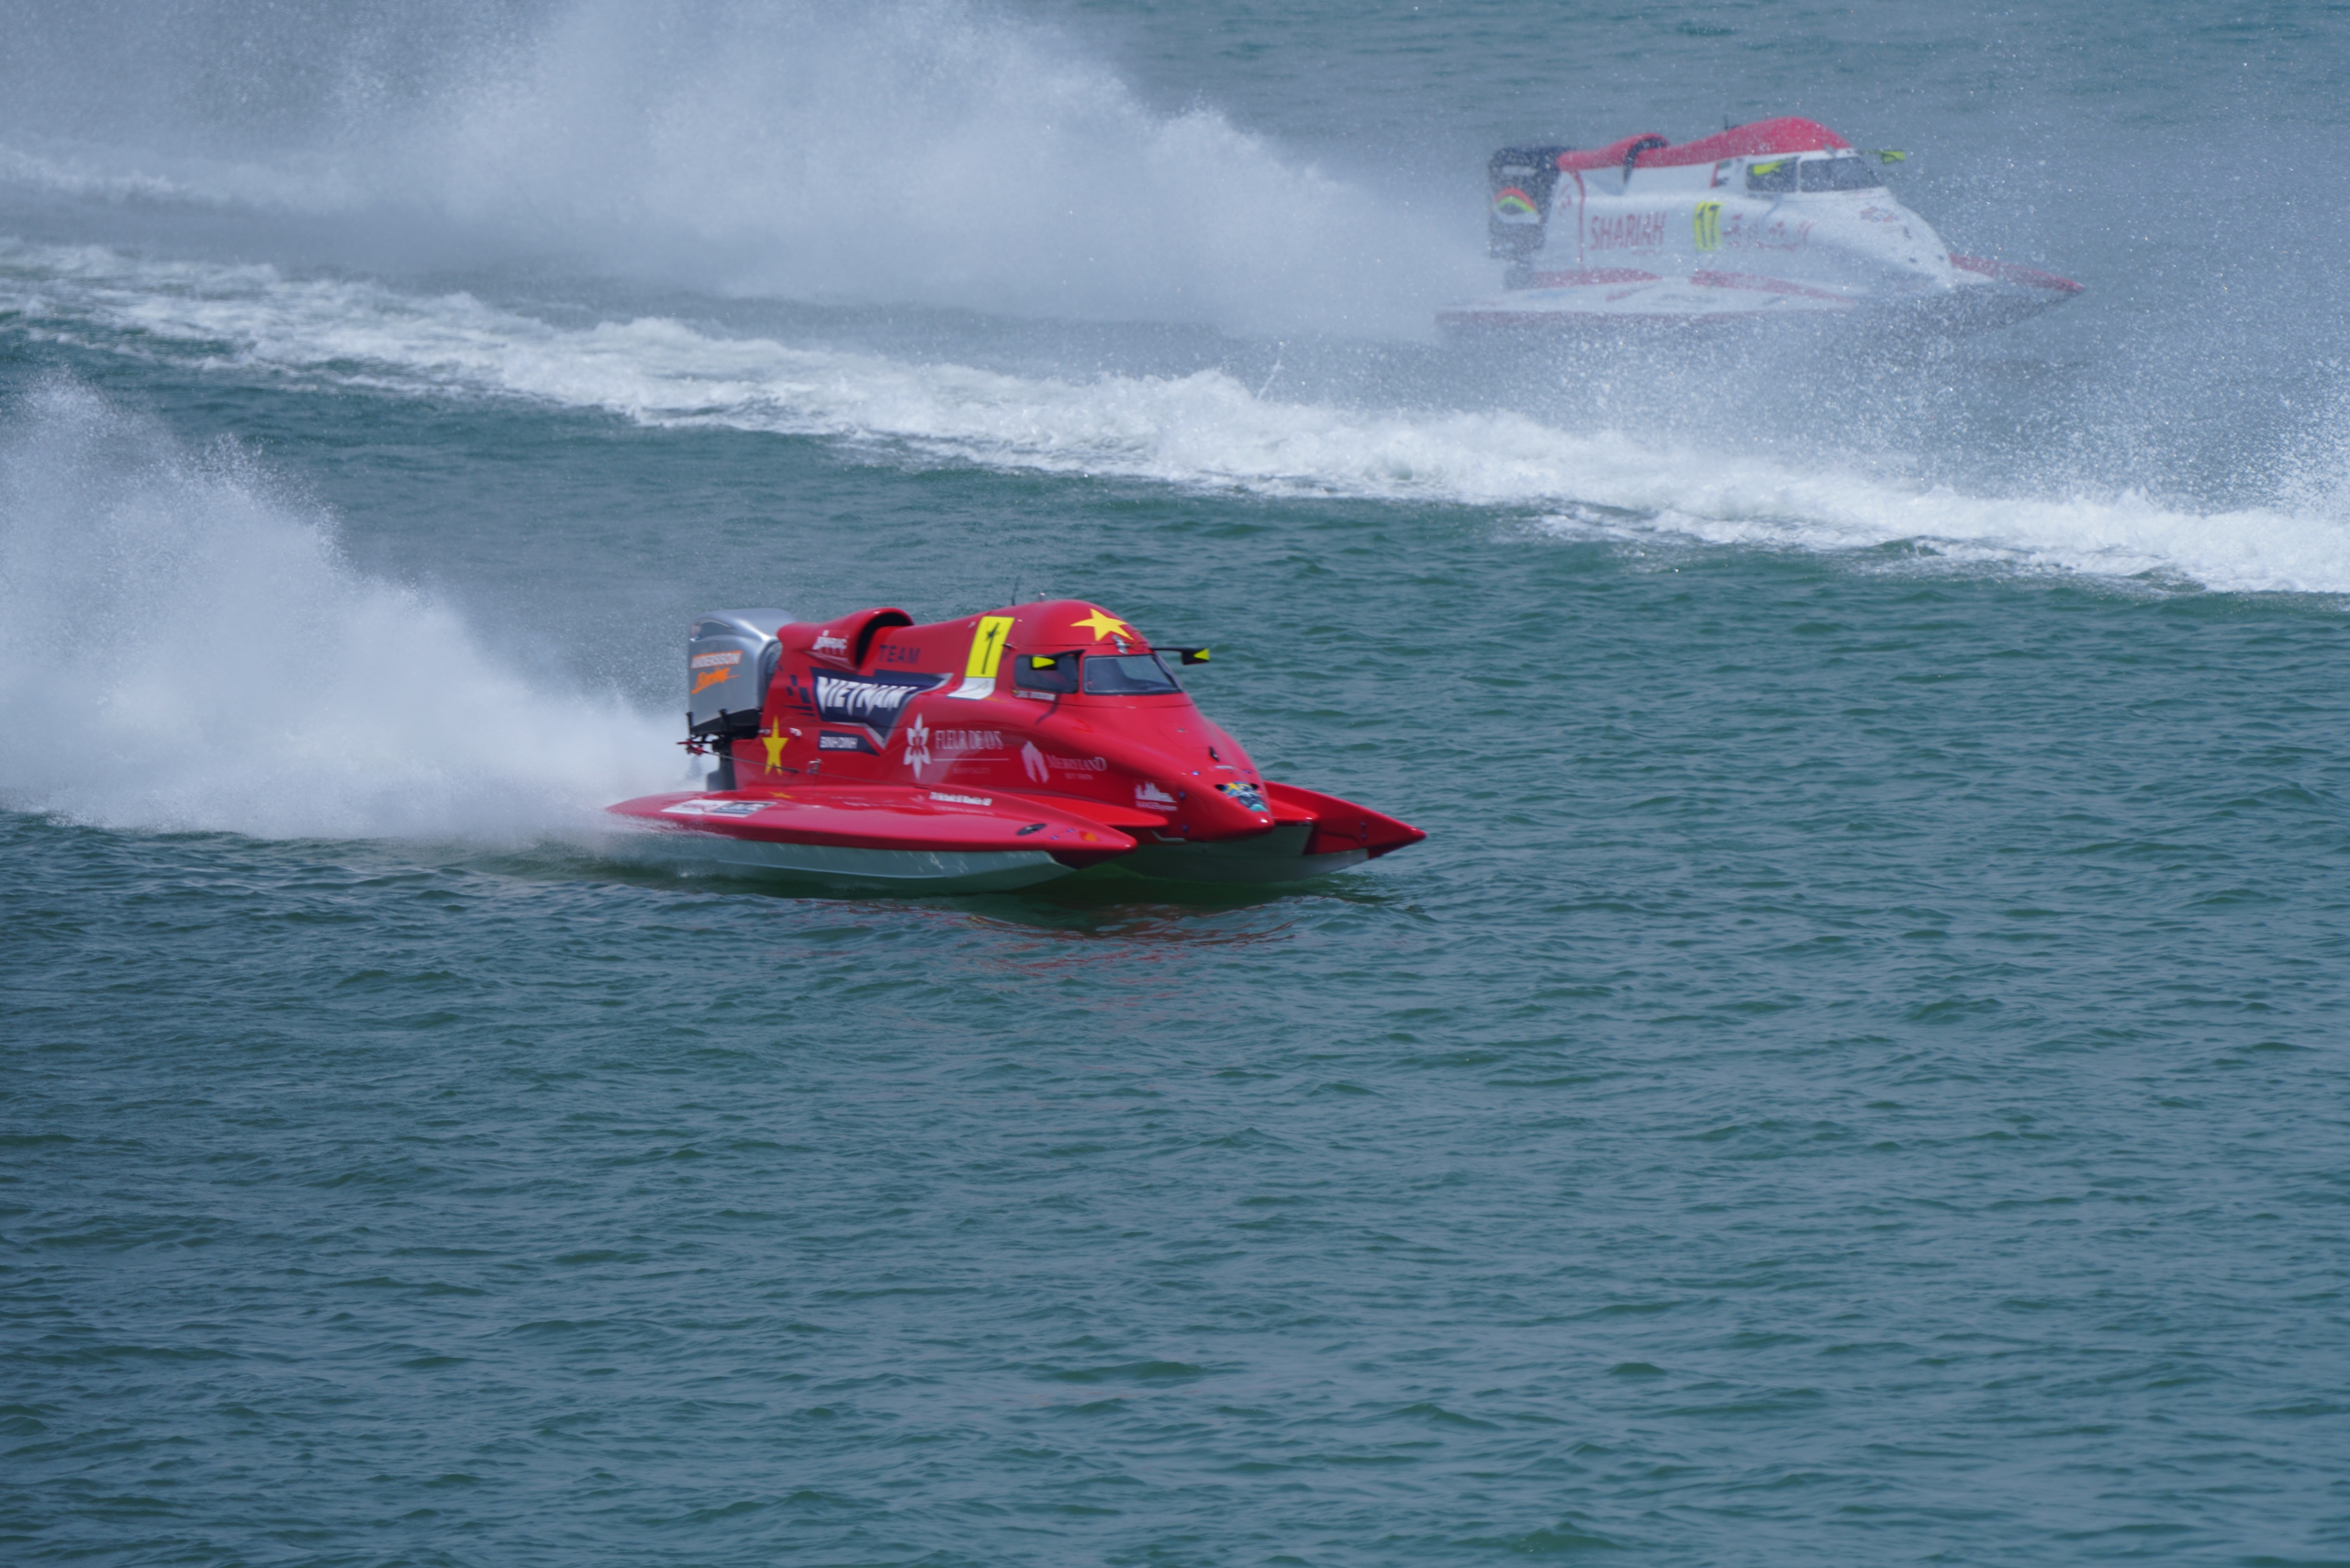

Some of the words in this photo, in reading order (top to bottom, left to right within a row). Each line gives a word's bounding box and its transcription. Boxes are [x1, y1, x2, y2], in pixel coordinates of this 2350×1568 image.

[1590, 210, 1667, 251] SHARJAH
[878, 644, 921, 665] TEAM
[816, 676, 918, 717] VIETNAM
